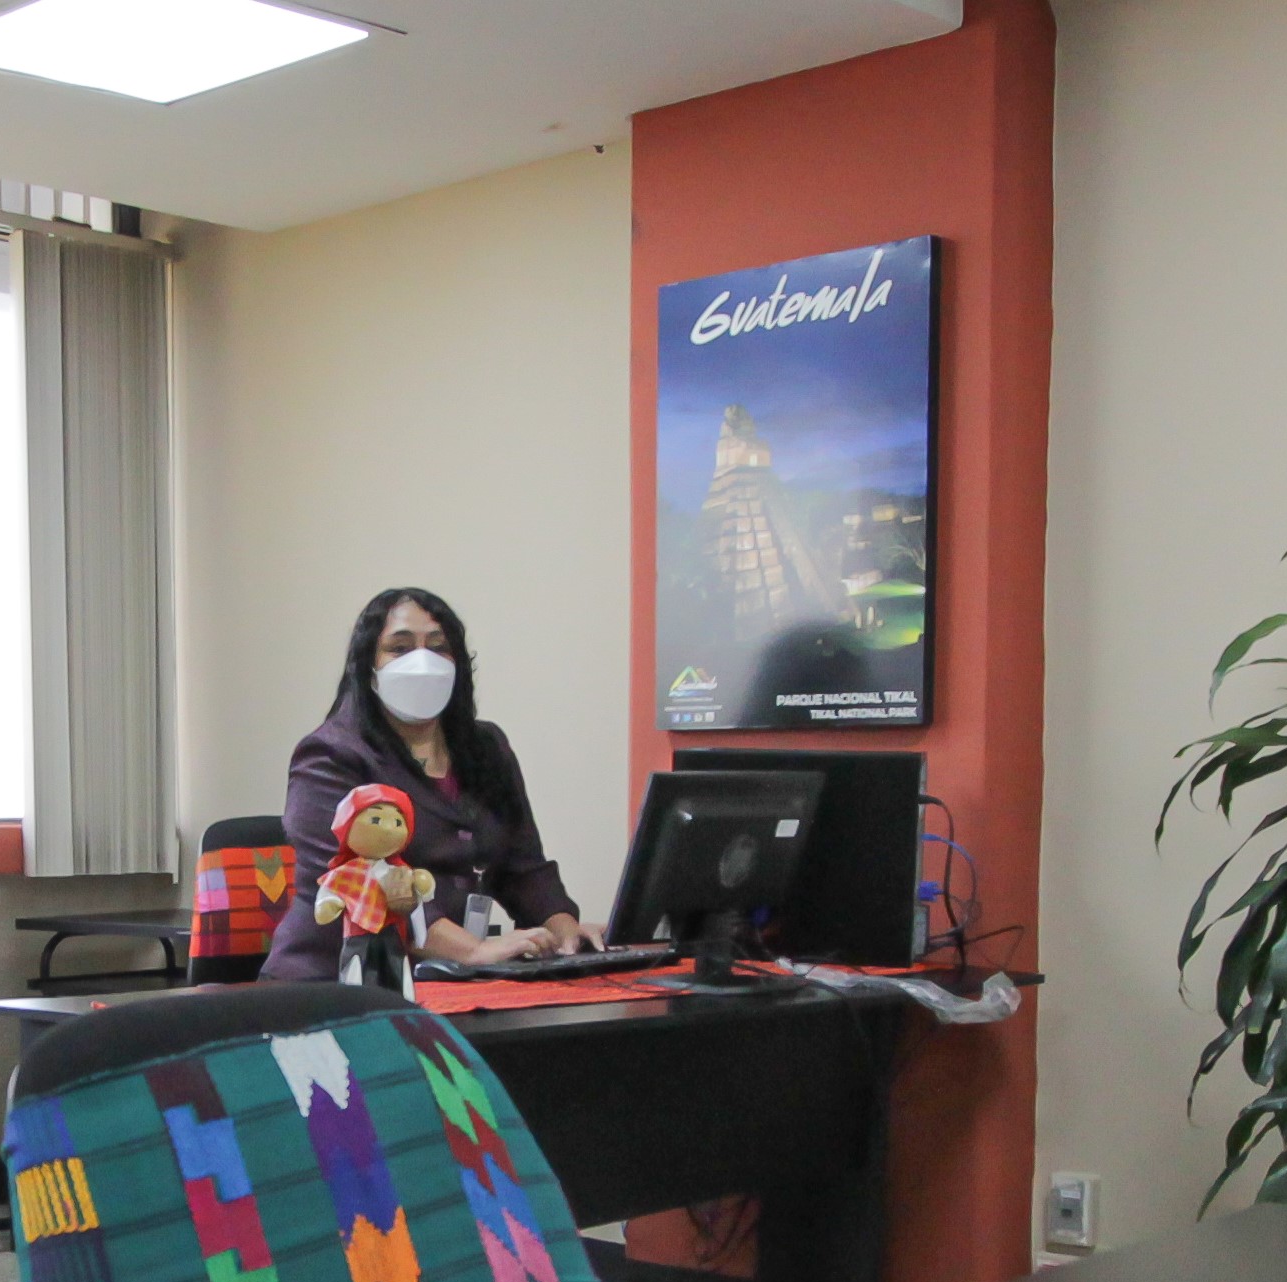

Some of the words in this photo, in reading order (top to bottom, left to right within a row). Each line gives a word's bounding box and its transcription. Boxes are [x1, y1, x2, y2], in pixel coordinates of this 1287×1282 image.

[690, 248, 893, 345] Guatemala
[776, 694, 823, 706] PARQUE
[824, 692, 882, 705] NACIONAL
[884, 690, 917, 703] TIKAL
[810, 709, 837, 719] TIKAL
[888, 706, 917, 717] PARK
